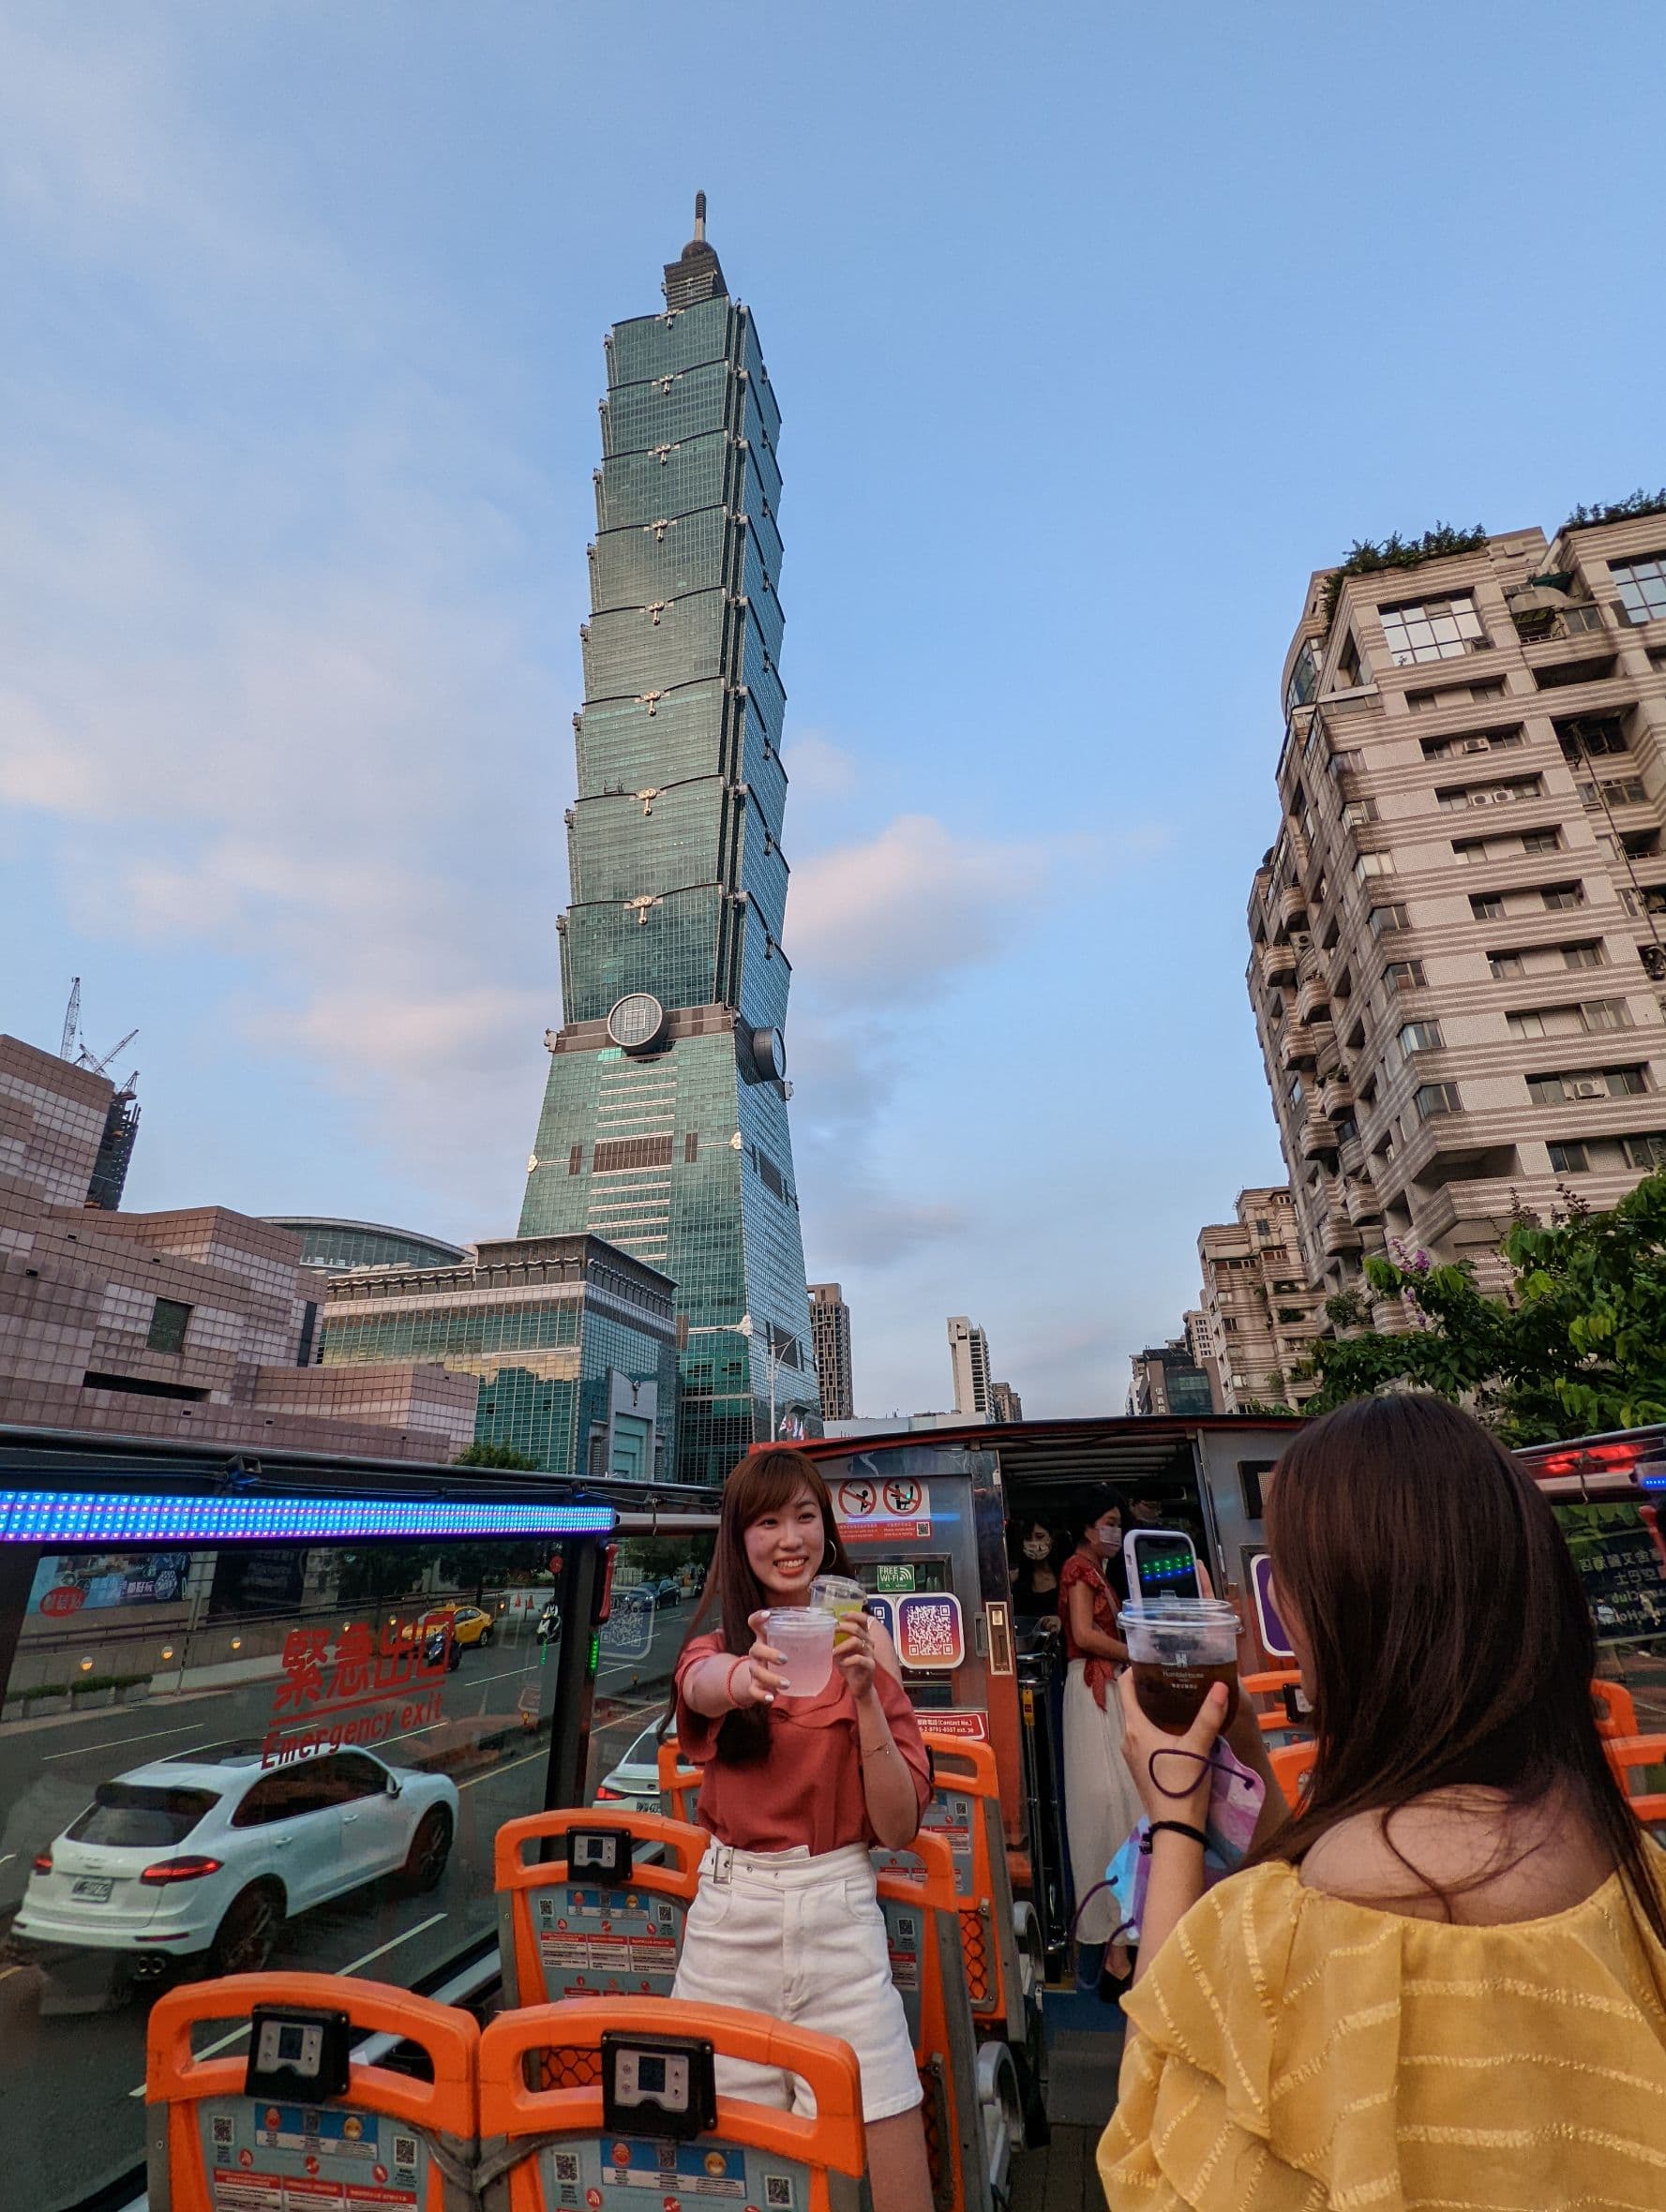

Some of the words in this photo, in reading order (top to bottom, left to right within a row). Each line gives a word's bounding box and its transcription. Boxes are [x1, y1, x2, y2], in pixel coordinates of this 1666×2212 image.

[272, 1610, 455, 1711] 緊急出口
[262, 1710, 395, 1770] Emergency
[399, 1692, 443, 1729] exit
